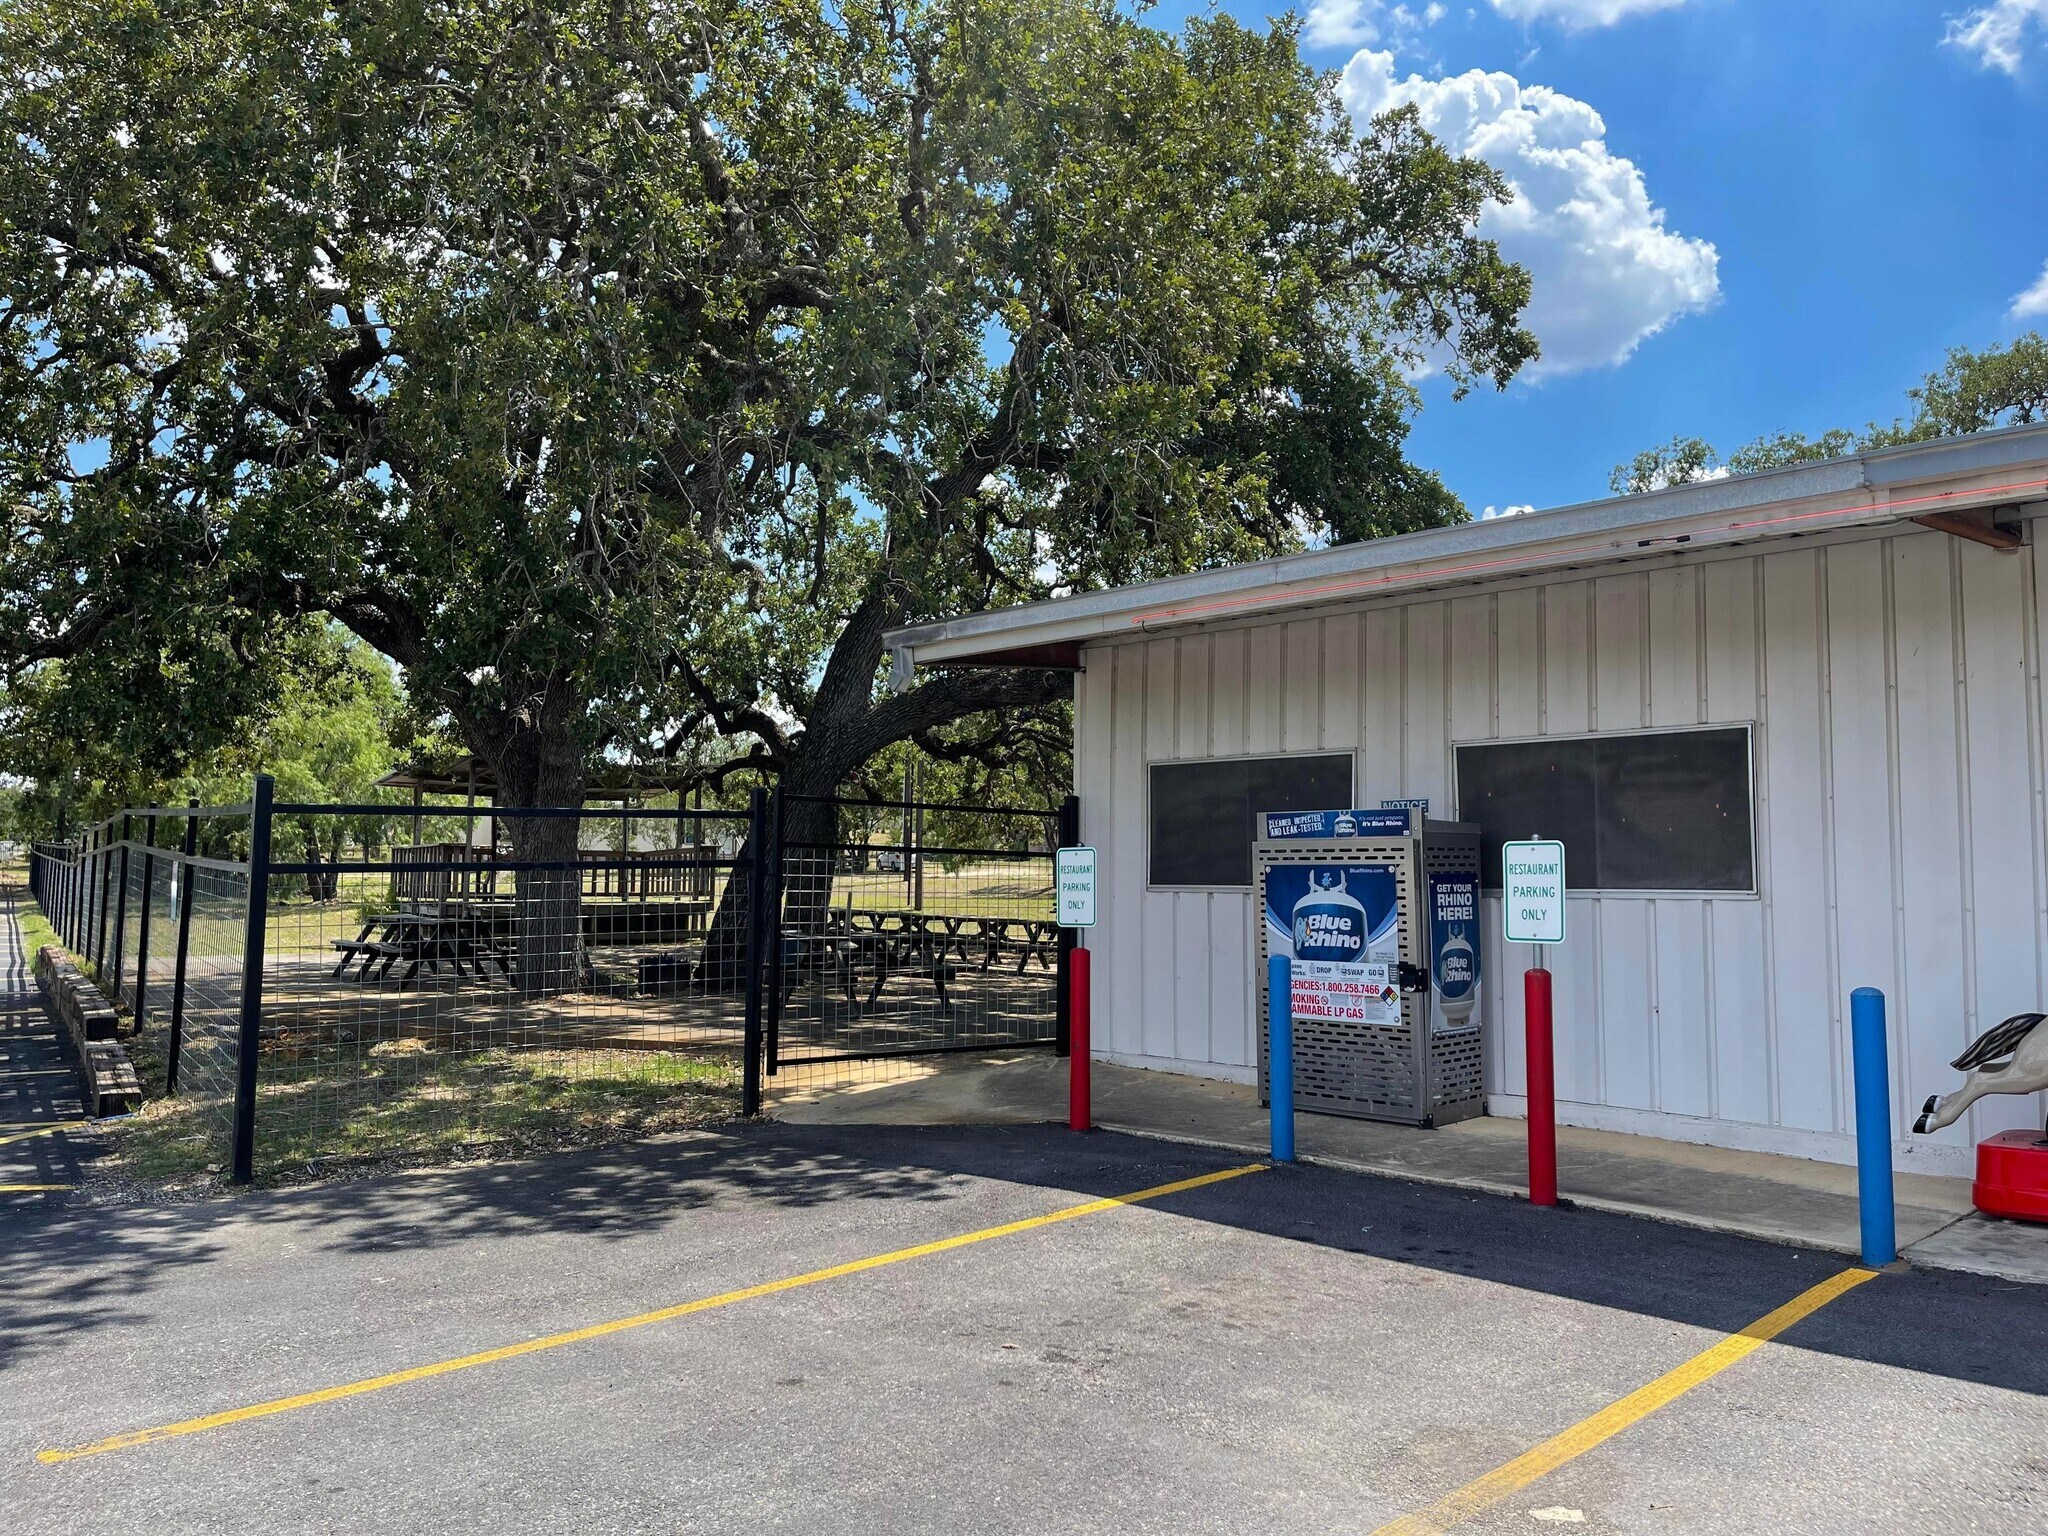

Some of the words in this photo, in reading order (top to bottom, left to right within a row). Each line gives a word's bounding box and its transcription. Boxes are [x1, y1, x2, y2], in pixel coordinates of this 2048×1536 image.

[1382, 800, 1427, 809] NOTICE
[1270, 827, 1282, 836] AND
[1282, 822, 1324, 835] LEAK-TESTED.
[1060, 865, 1092, 874] RESTAURANT
[1509, 863, 1558, 875] RESTAURANT
[1062, 882, 1090, 892] PARKING
[1437, 884, 1451, 893] GET
[1452, 884, 1472, 893] YOUR
[1513, 886, 1555, 898] PARKING
[1068, 900, 1085, 910] ONLY
[1437, 893, 1472, 906] RHINO
[1438, 907, 1473, 921] HERE!
[1521, 909, 1547, 921] ONLY
[1308, 914, 1351, 930] Blue
[1304, 930, 1361, 949] Rhino
[1447, 956, 1467, 969] Blue
[1316, 966, 1332, 974] DROP
[1347, 968, 1364, 976] SWAP
[1445, 967, 1471, 982] Rhino
[1334, 1006, 1344, 1017] LP
[1346, 1007, 1364, 1019] GAS
